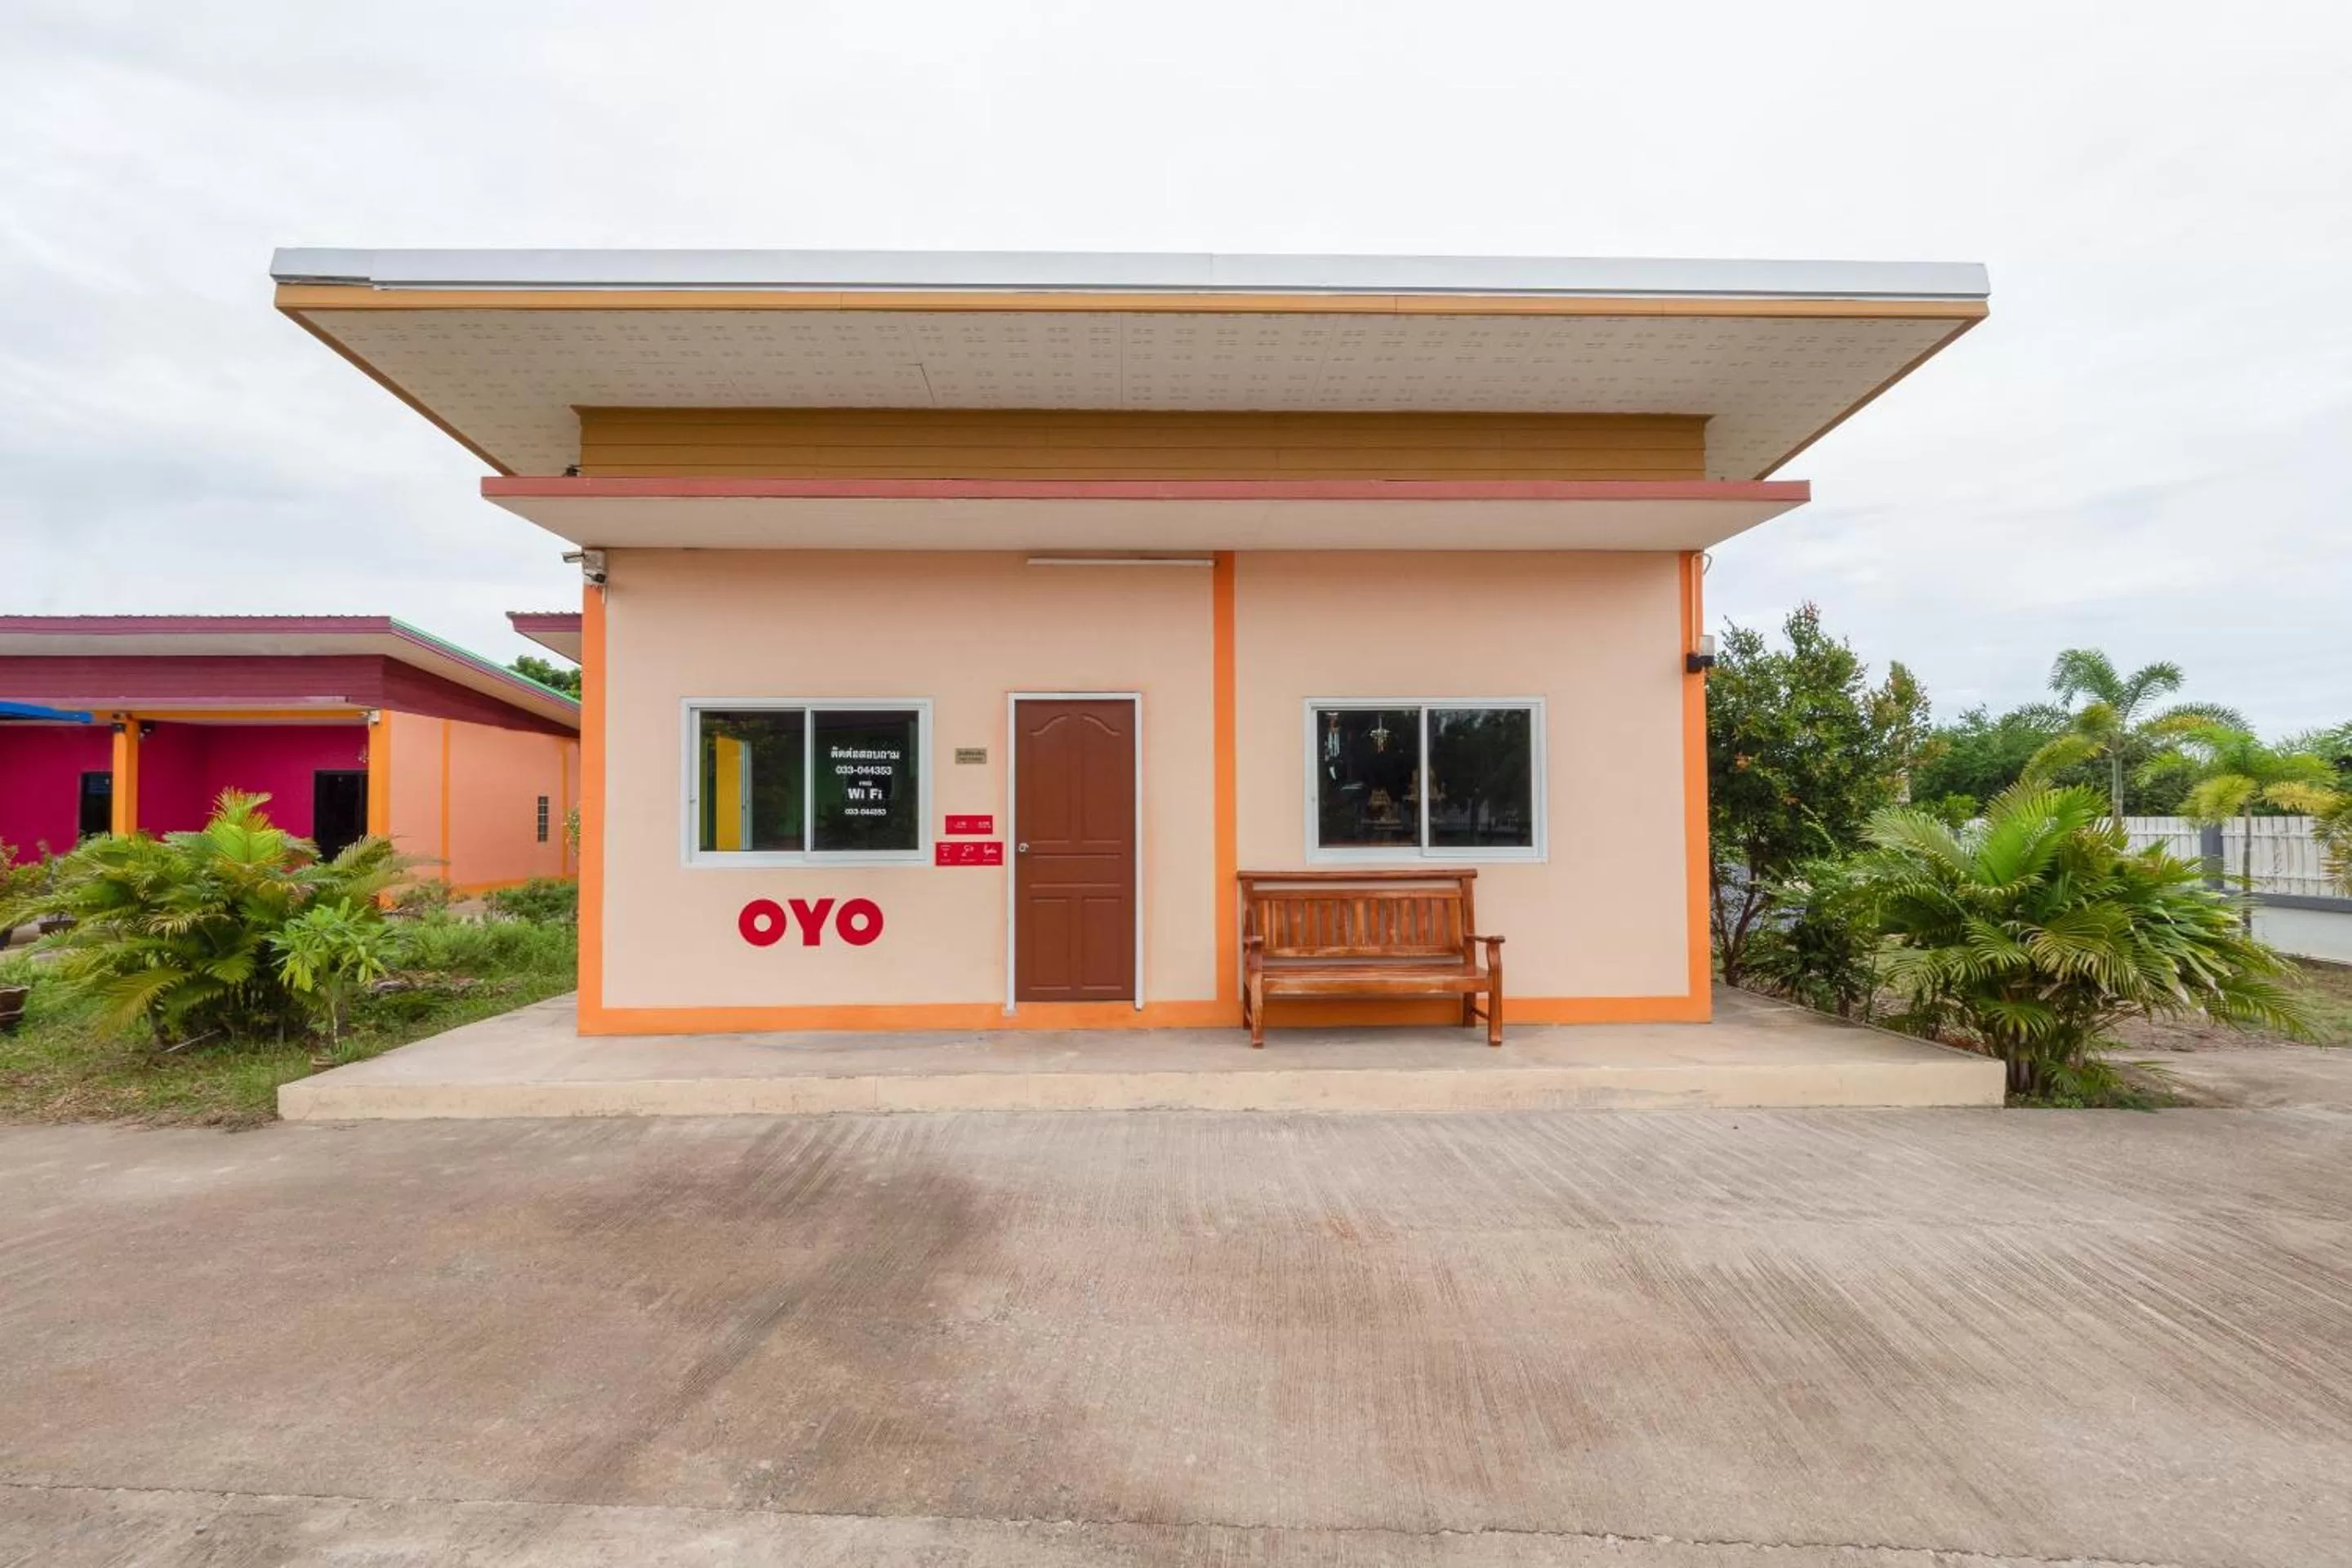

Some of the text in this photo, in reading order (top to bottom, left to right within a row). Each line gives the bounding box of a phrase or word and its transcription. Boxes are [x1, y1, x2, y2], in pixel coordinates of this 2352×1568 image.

[835, 765, 893, 775] 033-044353
[848, 788, 882, 800] Wi Fi
[738, 898, 884, 947] OYO
